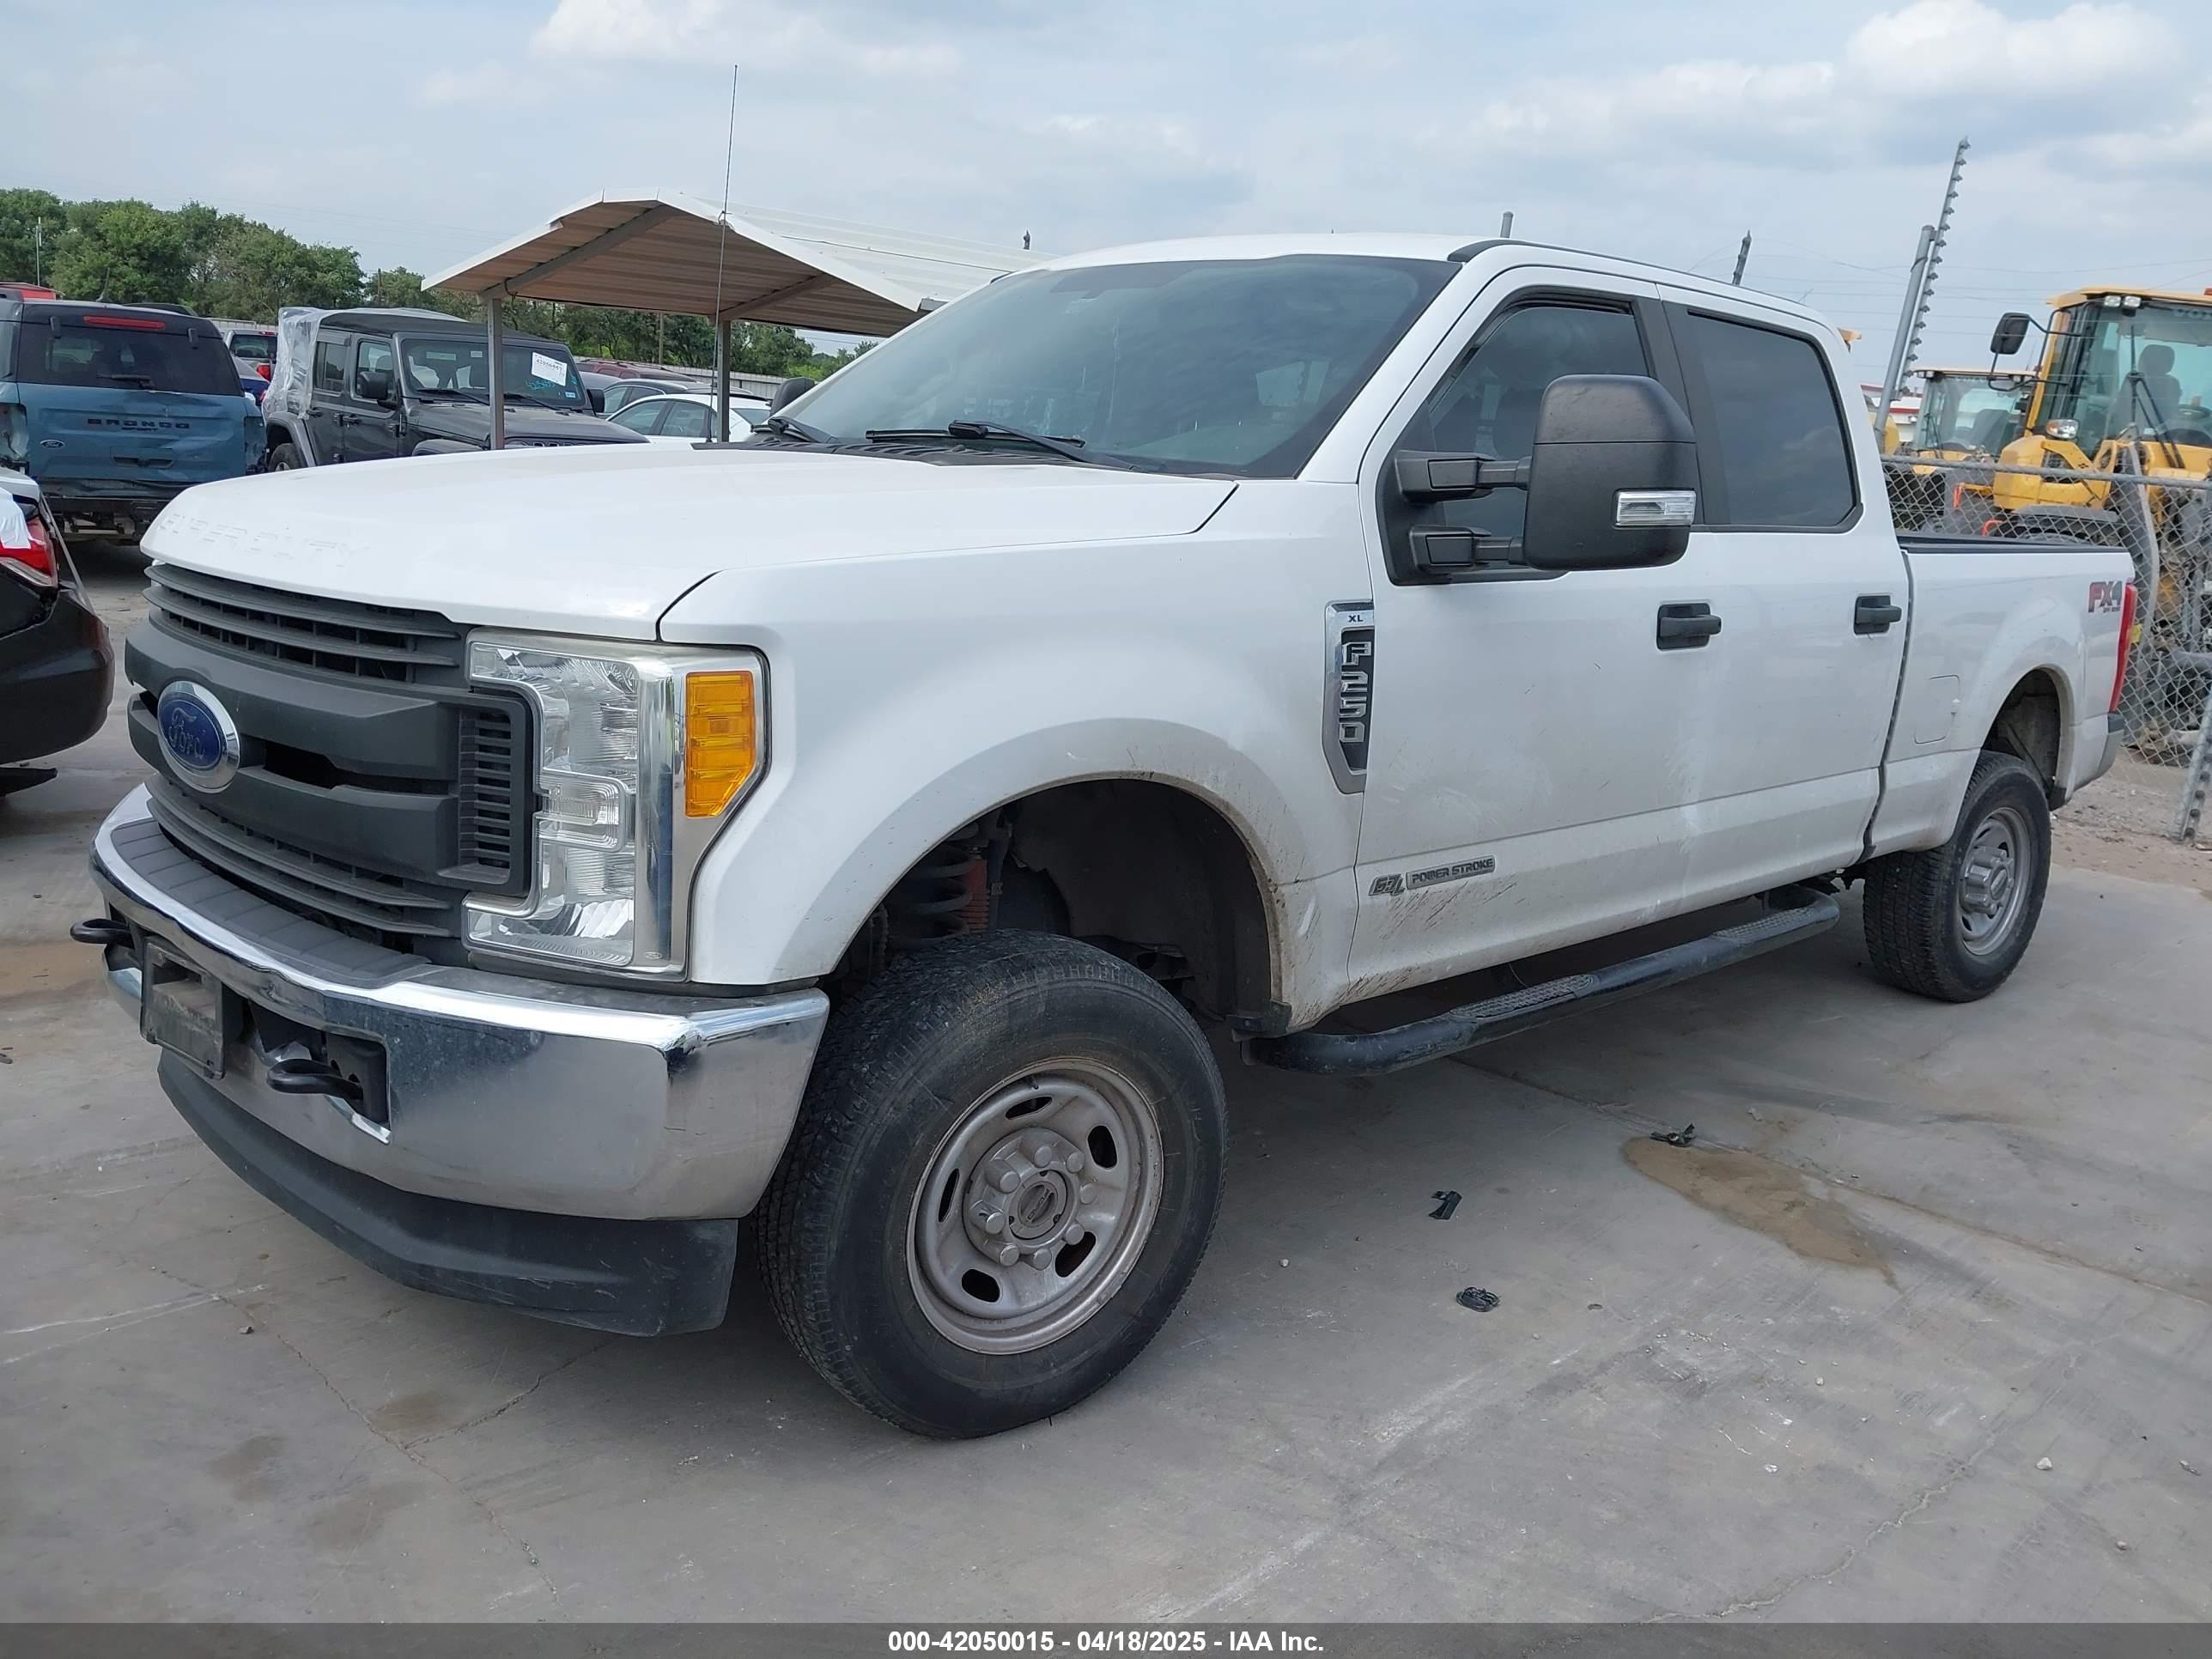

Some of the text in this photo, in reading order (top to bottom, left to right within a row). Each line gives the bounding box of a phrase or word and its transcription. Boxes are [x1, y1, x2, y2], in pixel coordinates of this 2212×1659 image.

[88, 419, 190, 429] BRONCO
[2088, 580, 2123, 613] FX4
[1348, 614, 1364, 623] XL
[169, 707, 206, 761] Ford
[1413, 867, 1449, 884] POWER
[1451, 858, 1494, 876] STROKE
